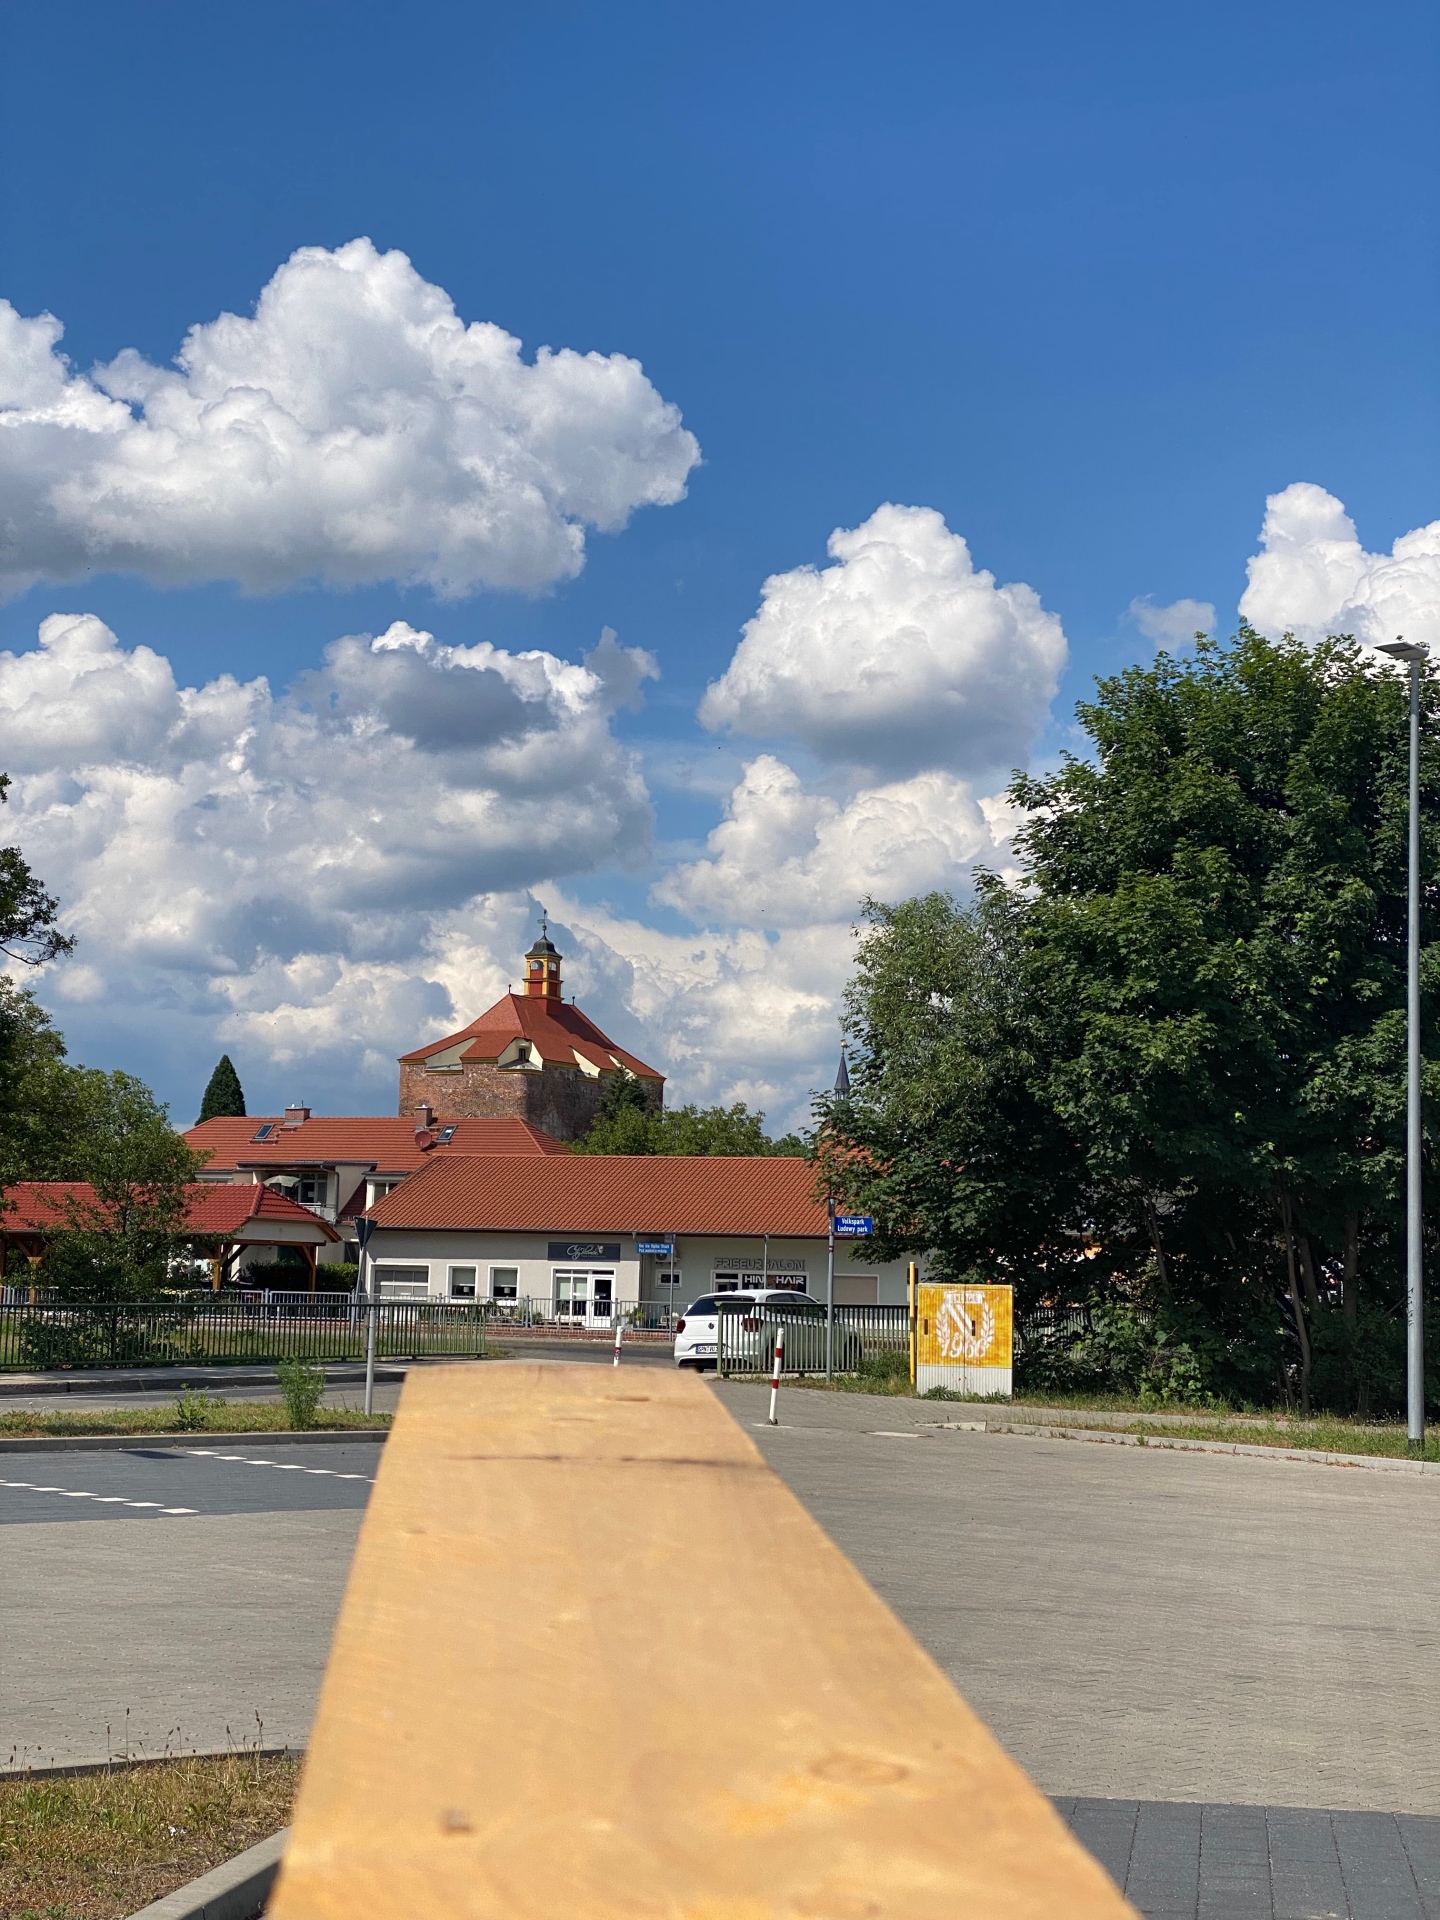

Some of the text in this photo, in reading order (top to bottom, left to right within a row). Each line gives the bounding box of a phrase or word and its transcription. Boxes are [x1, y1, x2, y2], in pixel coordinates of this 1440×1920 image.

[841, 1217, 865, 1226] Volkspark
[837, 1225, 868, 1234] Ludowy park
[776, 1276, 804, 1285] HAIR
